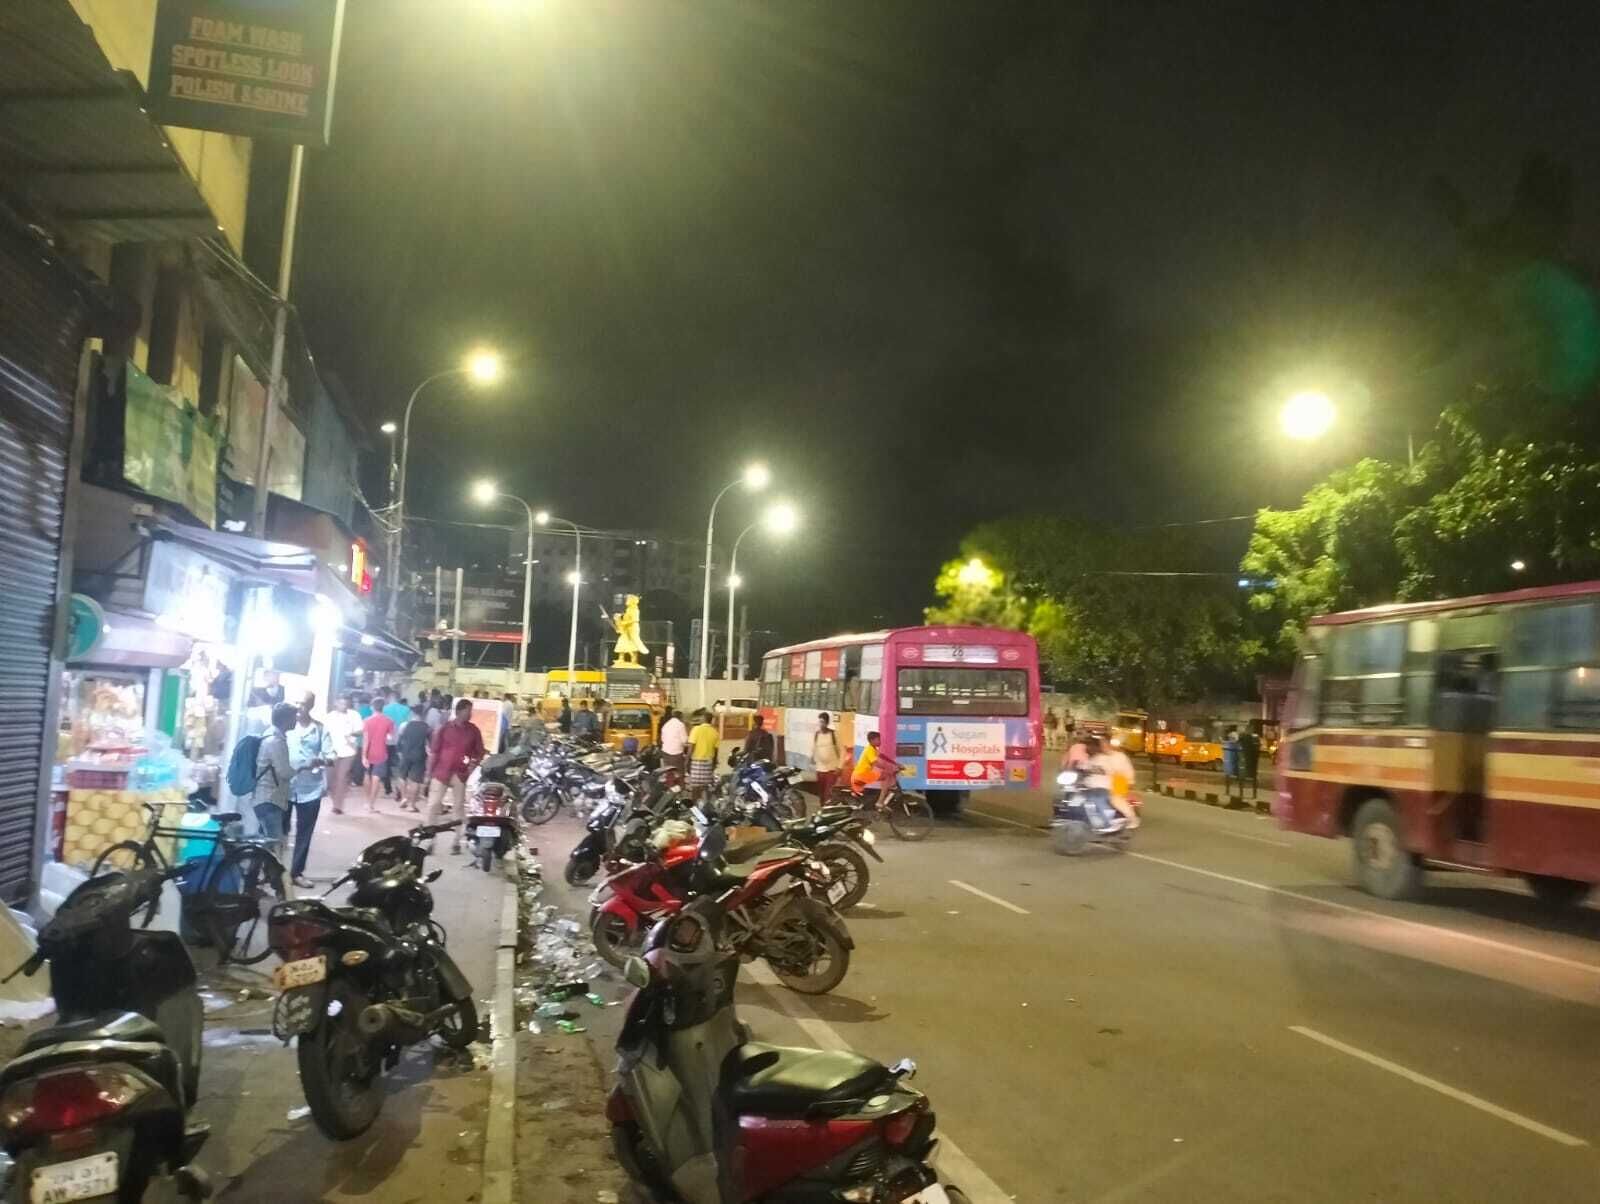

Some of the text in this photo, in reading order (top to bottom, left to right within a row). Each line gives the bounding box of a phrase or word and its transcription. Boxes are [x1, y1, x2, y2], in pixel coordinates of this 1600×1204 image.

[191, 16, 303, 52] FOAM WASH
[171, 44, 315, 86] SPOTLESS LOOK
[170, 75, 236, 101] POLISH
[951, 743, 1001, 756] Hospitals
